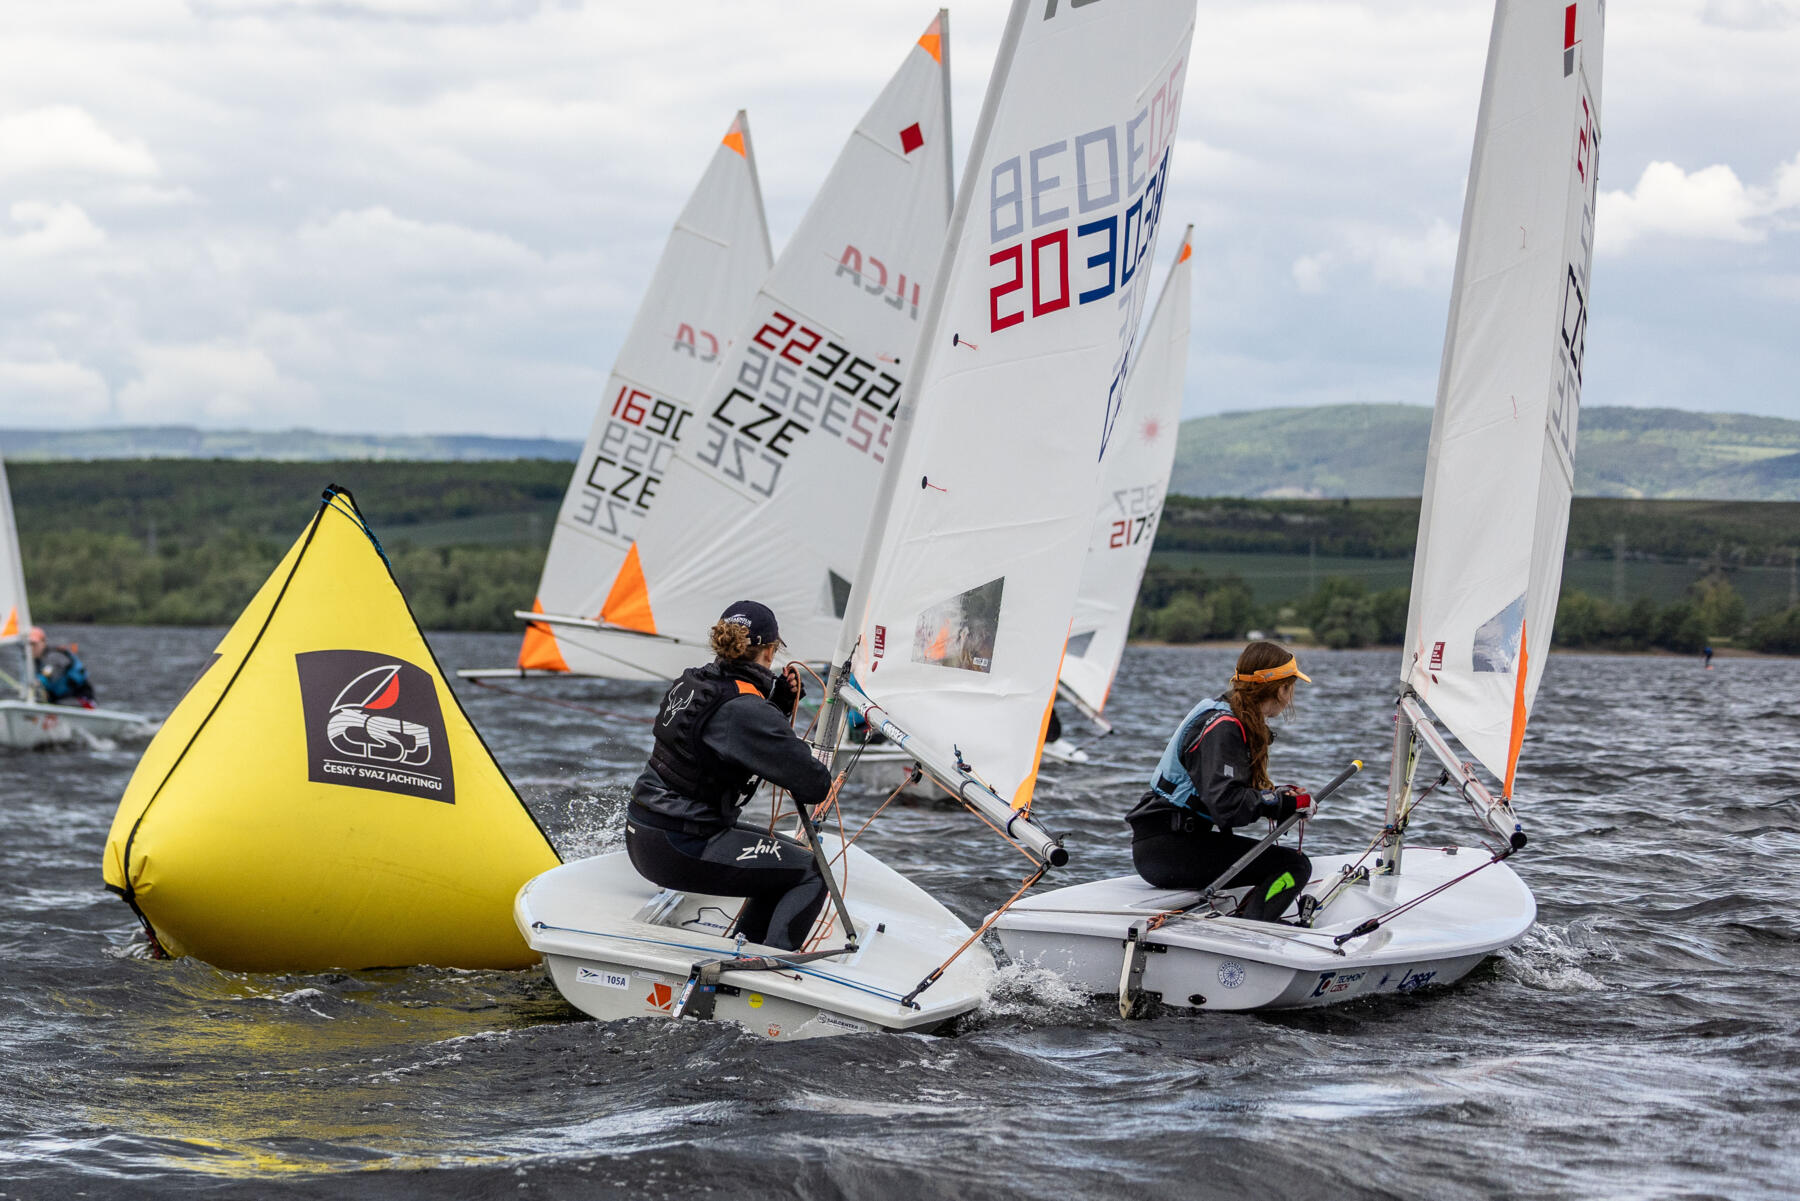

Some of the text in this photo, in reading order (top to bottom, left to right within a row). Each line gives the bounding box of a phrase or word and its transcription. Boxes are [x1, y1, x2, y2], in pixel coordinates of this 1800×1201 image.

[754, 311, 901, 421] 22352
[711, 388, 809, 457] CZE
[586, 456, 660, 509] CZE
[323, 763, 442, 791] ČESKÝ SVAZ JACHTINGU
[736, 839, 781, 861] zhik
[607, 975, 625, 987] 105A
